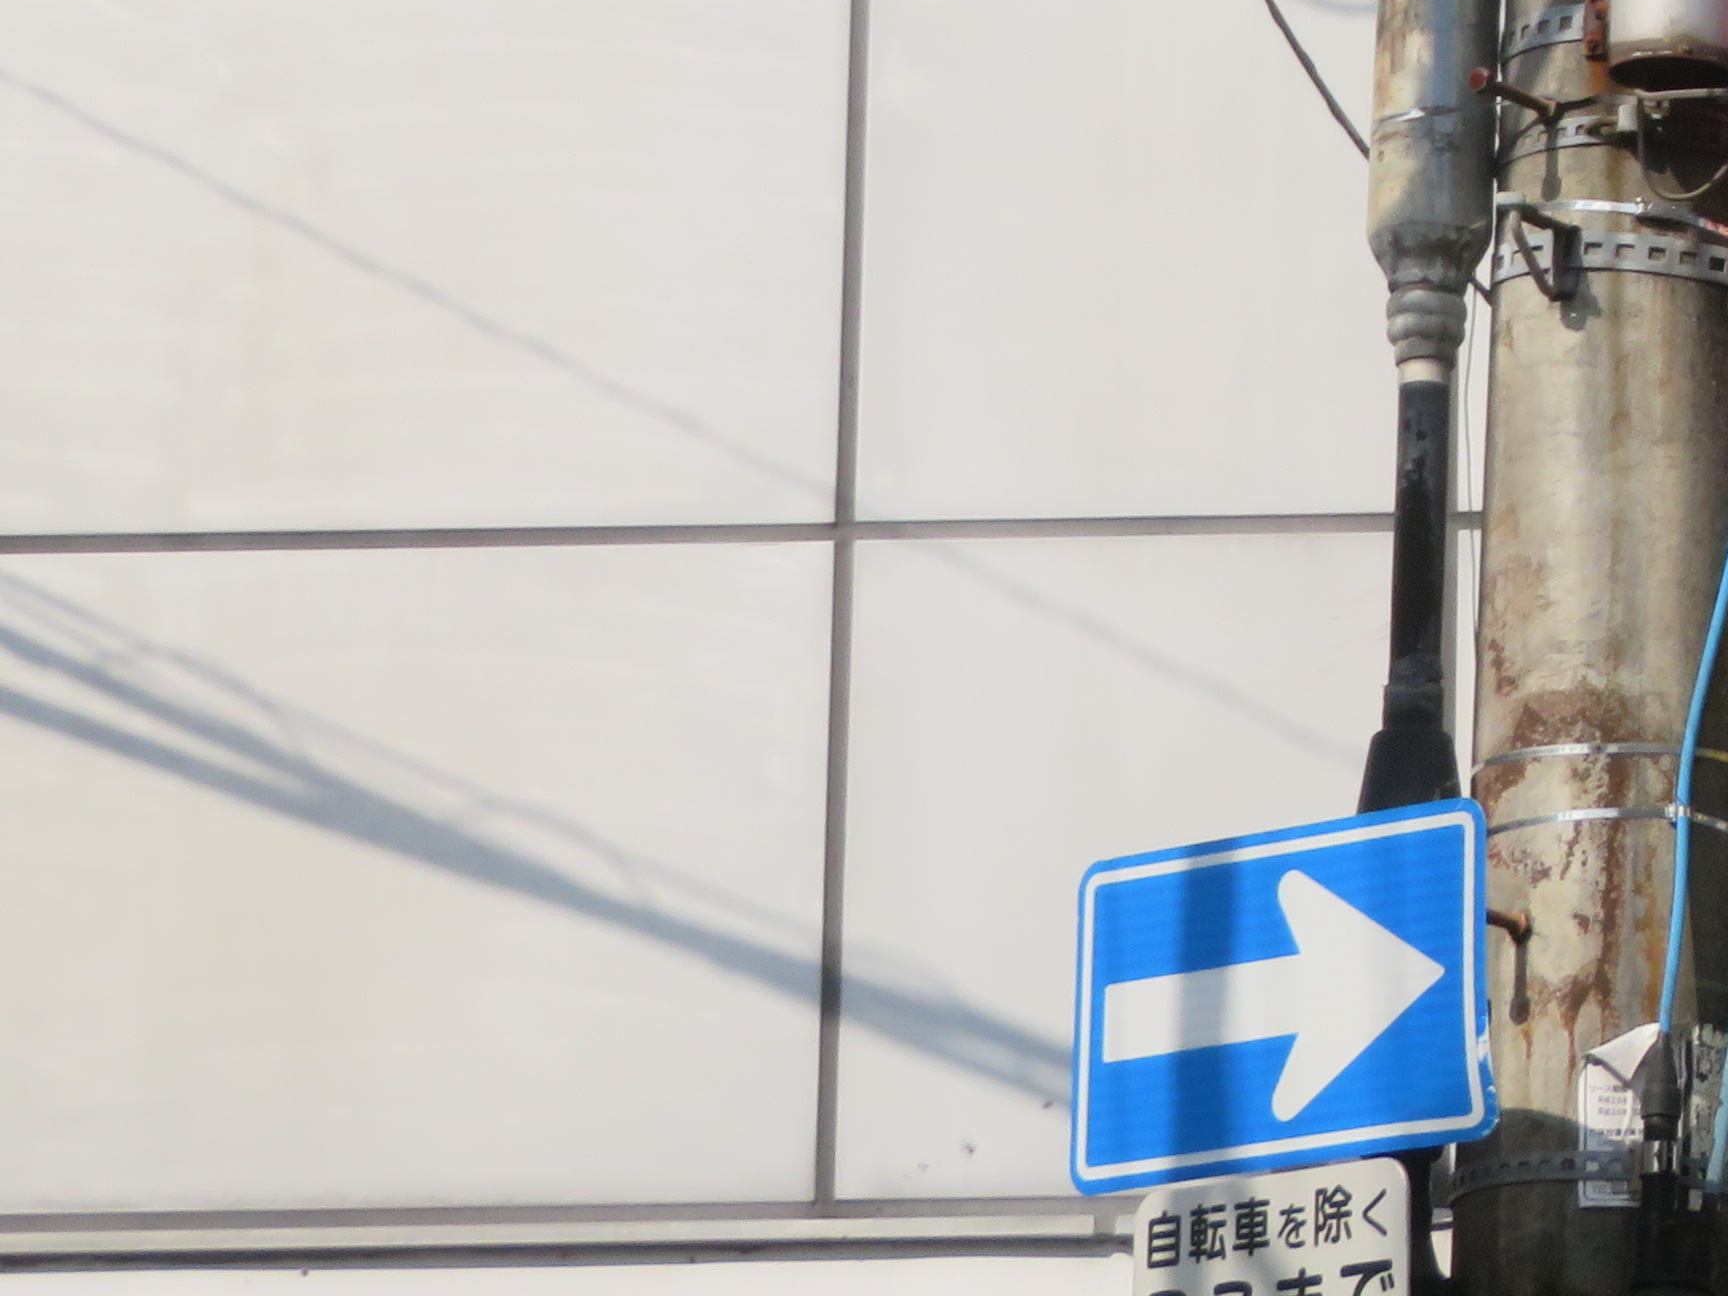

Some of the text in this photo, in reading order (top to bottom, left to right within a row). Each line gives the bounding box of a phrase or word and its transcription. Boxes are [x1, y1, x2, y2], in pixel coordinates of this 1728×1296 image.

[1147, 1184, 1389, 1269] 自転車を除く
